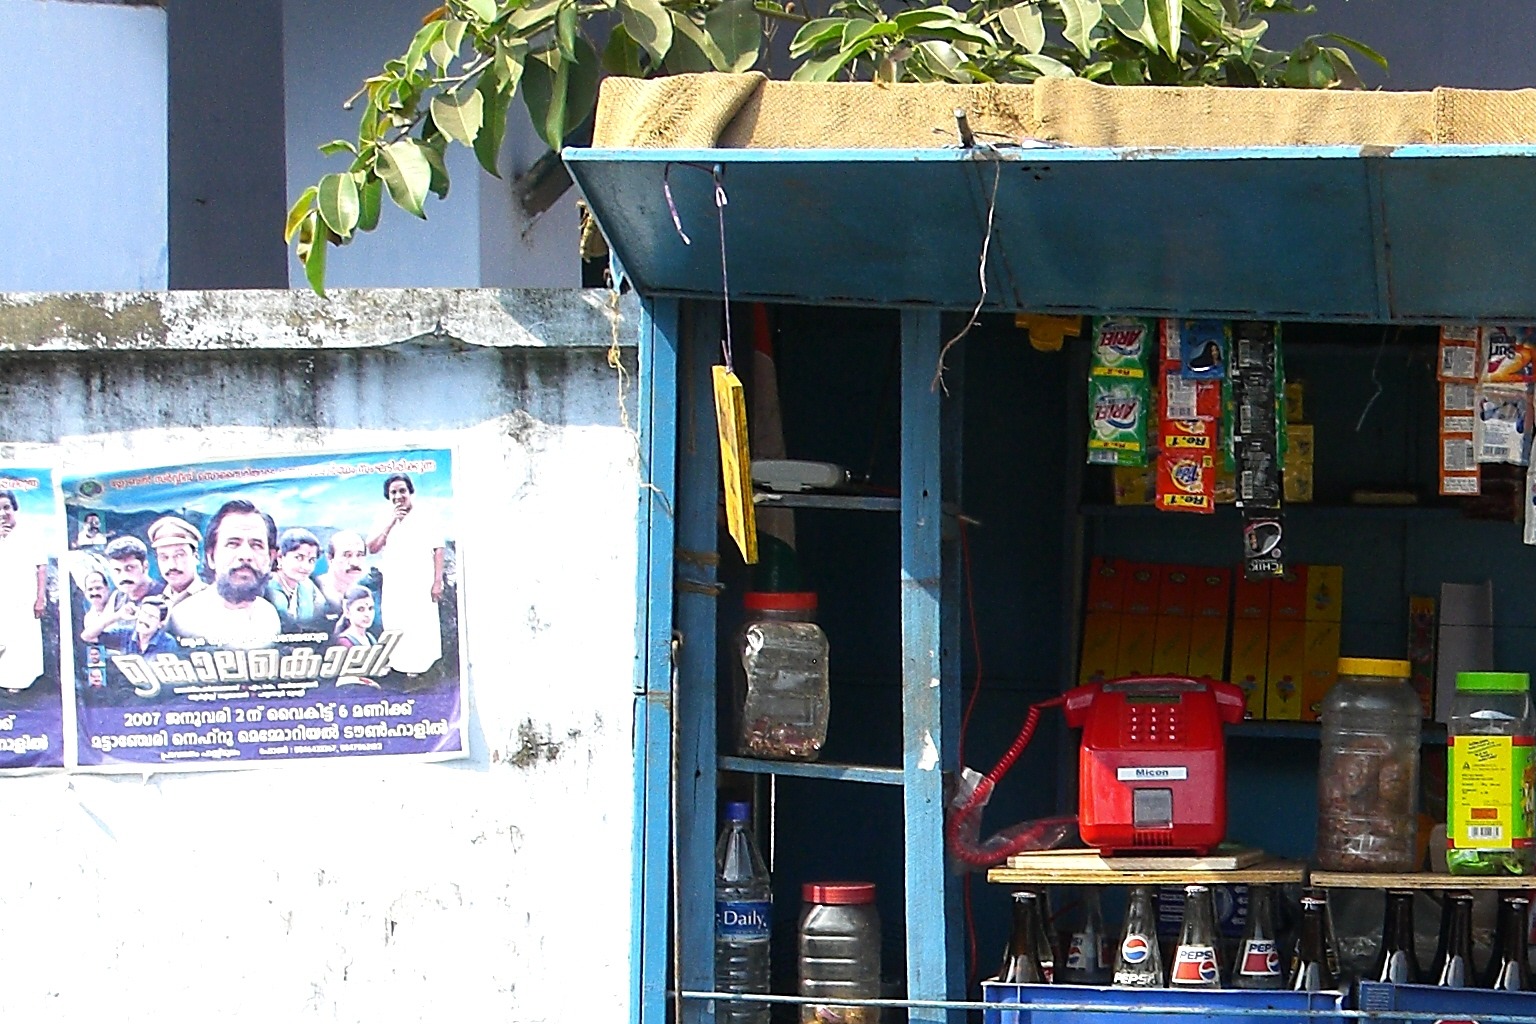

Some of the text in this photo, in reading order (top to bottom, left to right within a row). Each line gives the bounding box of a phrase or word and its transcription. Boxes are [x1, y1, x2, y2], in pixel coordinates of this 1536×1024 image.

[124, 712, 162, 727] 2007
[165, 706, 232, 727] ജനുവരി
[339, 703, 349, 718] 6
[1135, 768, 1169, 777] Micon
[724, 910, 765, 930] Daily
